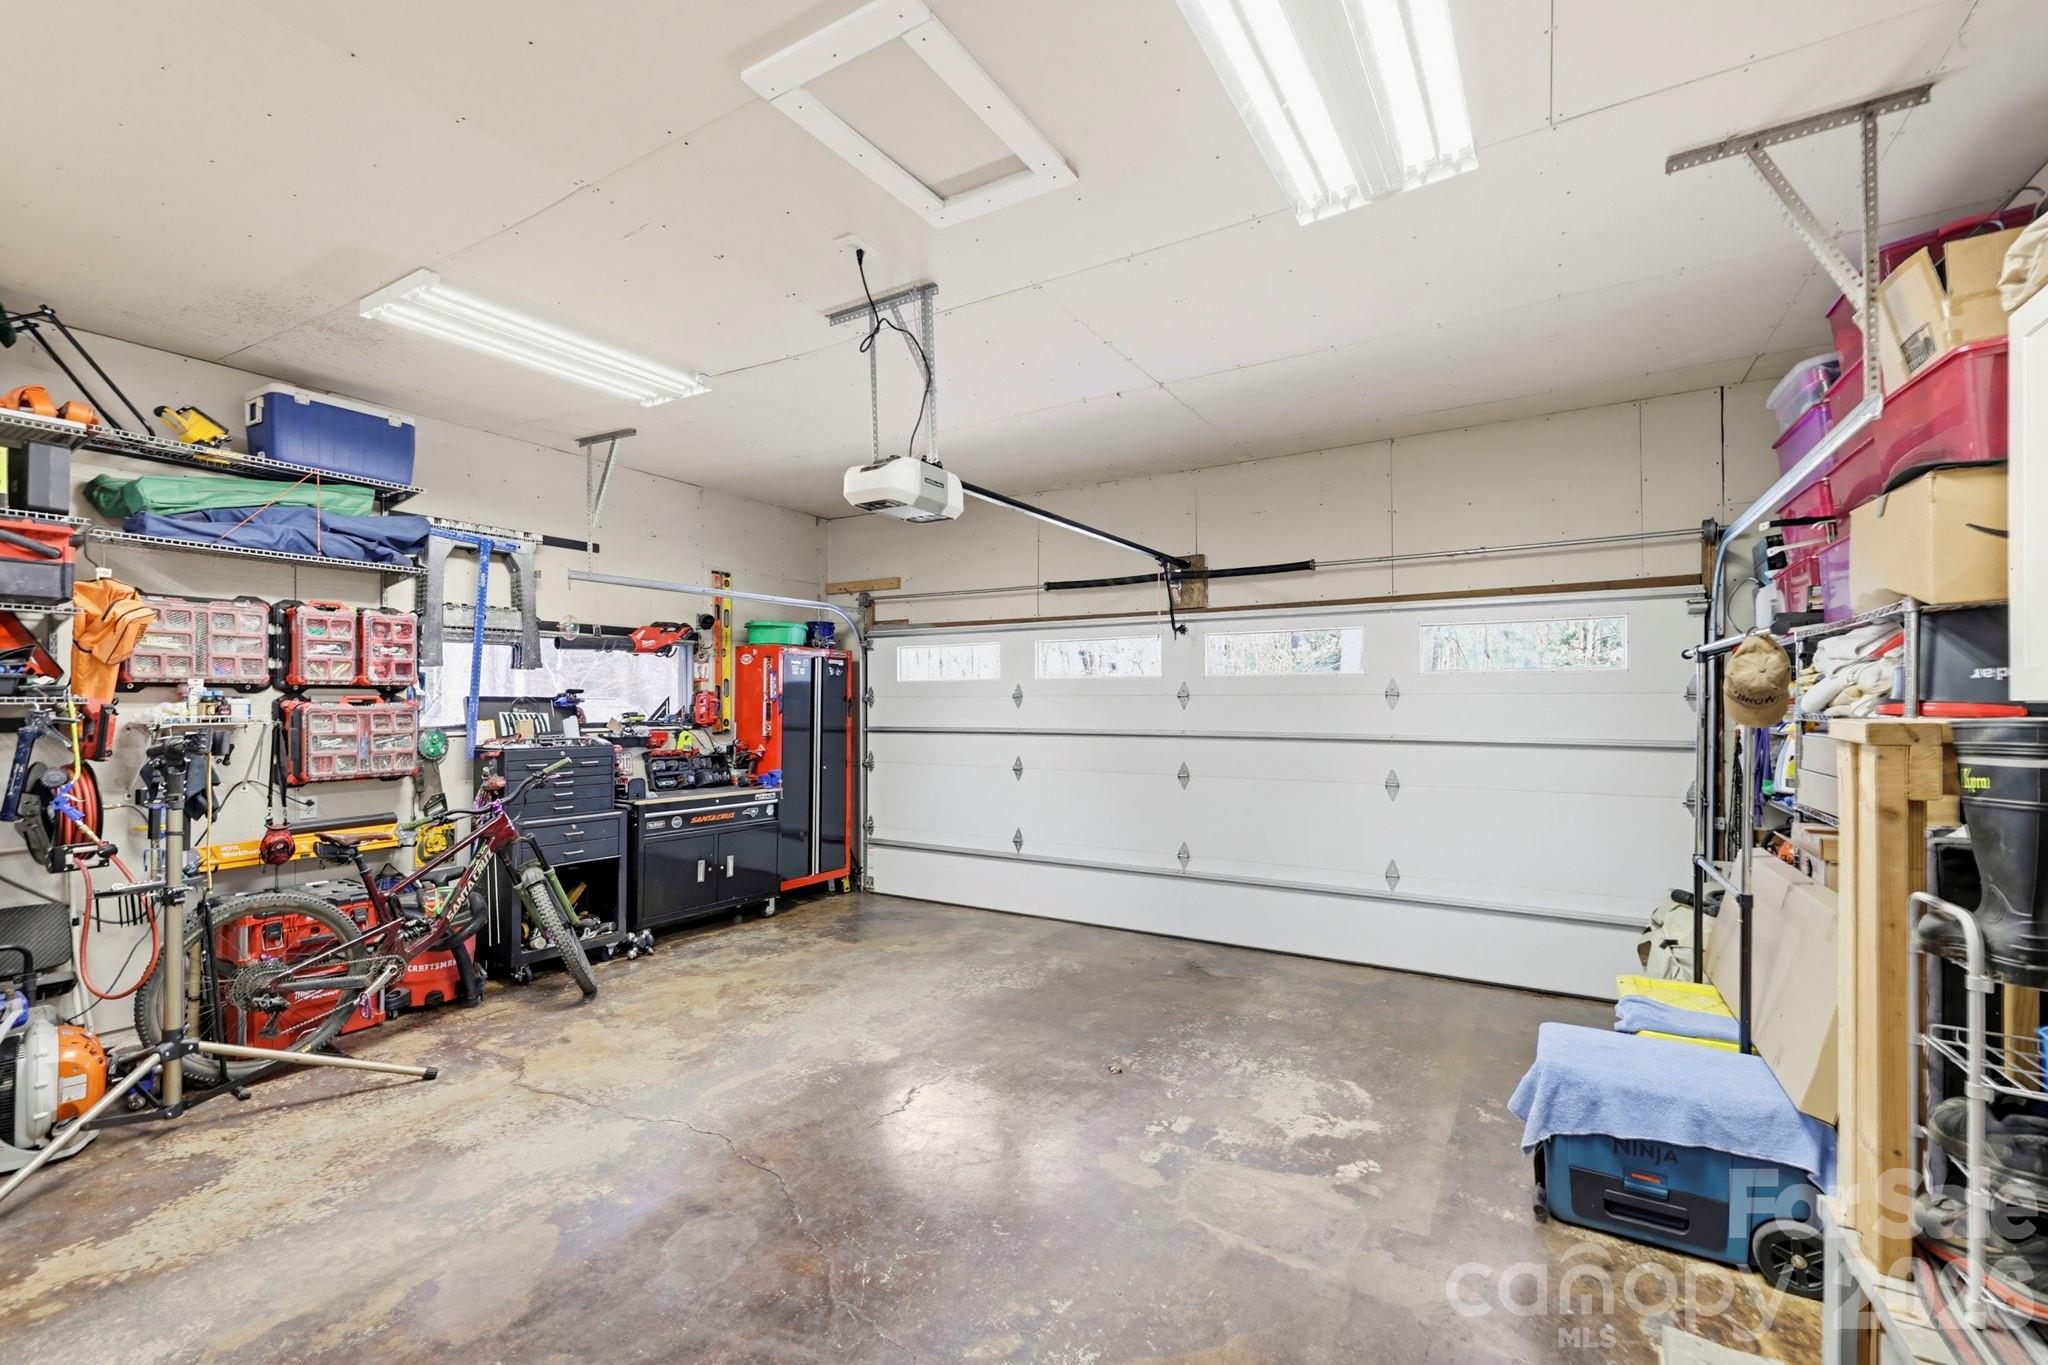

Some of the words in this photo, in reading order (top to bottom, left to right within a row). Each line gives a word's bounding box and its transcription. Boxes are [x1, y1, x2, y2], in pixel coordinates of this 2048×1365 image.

[446, 879, 476, 923] SANTA
[472, 848, 494, 881] CRUZ
[1612, 1139, 1679, 1166] NINJA
